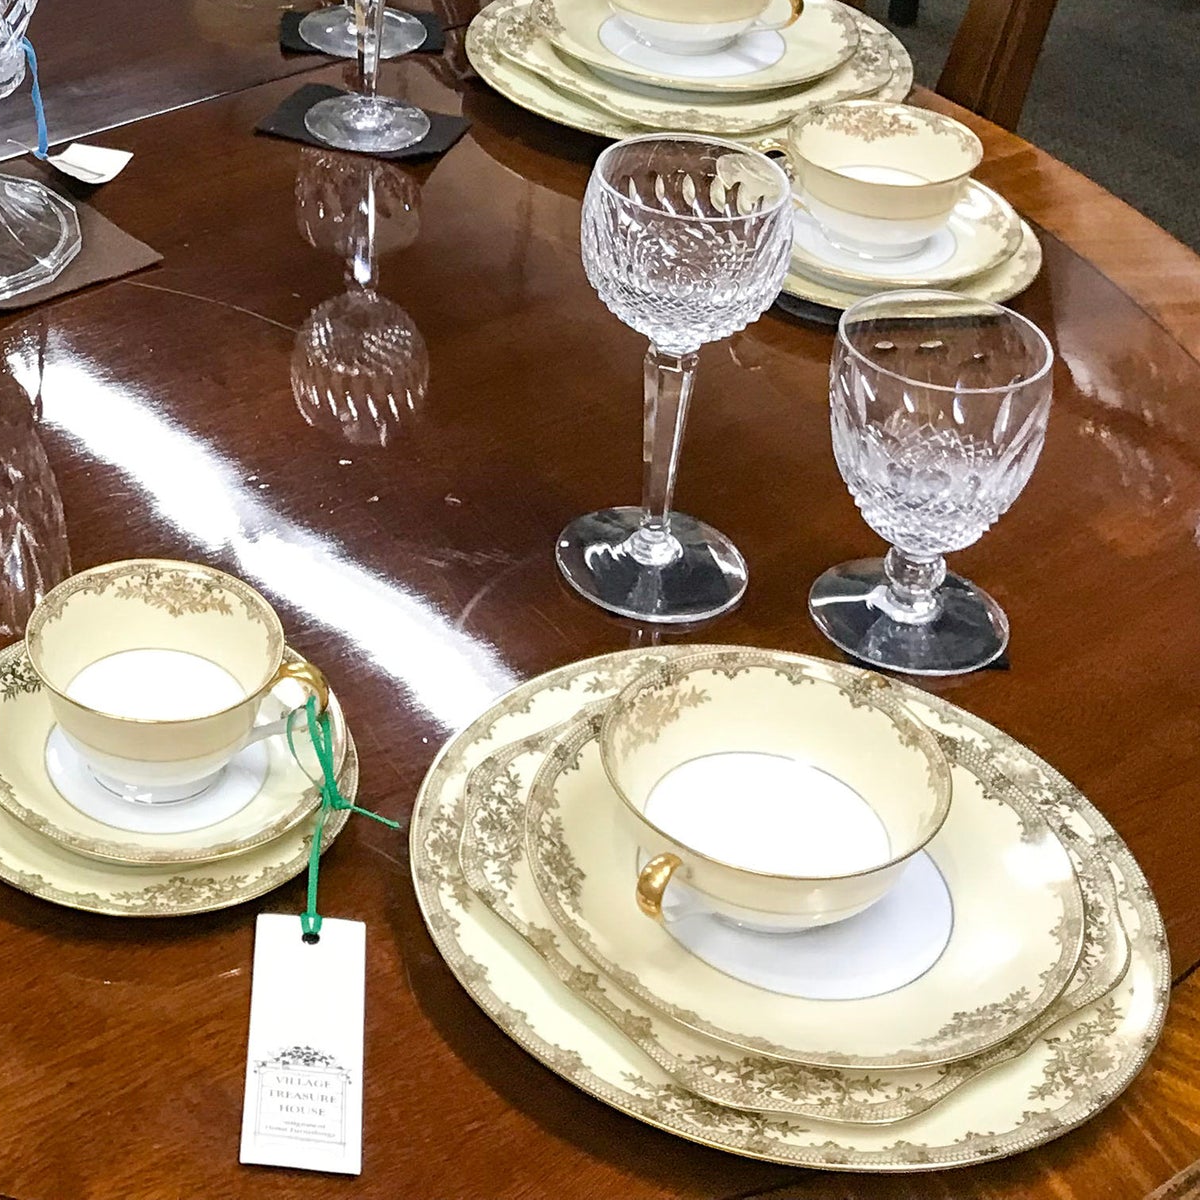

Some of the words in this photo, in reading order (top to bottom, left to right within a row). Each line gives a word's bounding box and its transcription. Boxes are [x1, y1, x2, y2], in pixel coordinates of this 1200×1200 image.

[276, 1076, 331, 1088] VILLAGE
[270, 1090, 336, 1103] TREASURE
[280, 1104, 325, 1116] HOUSE
